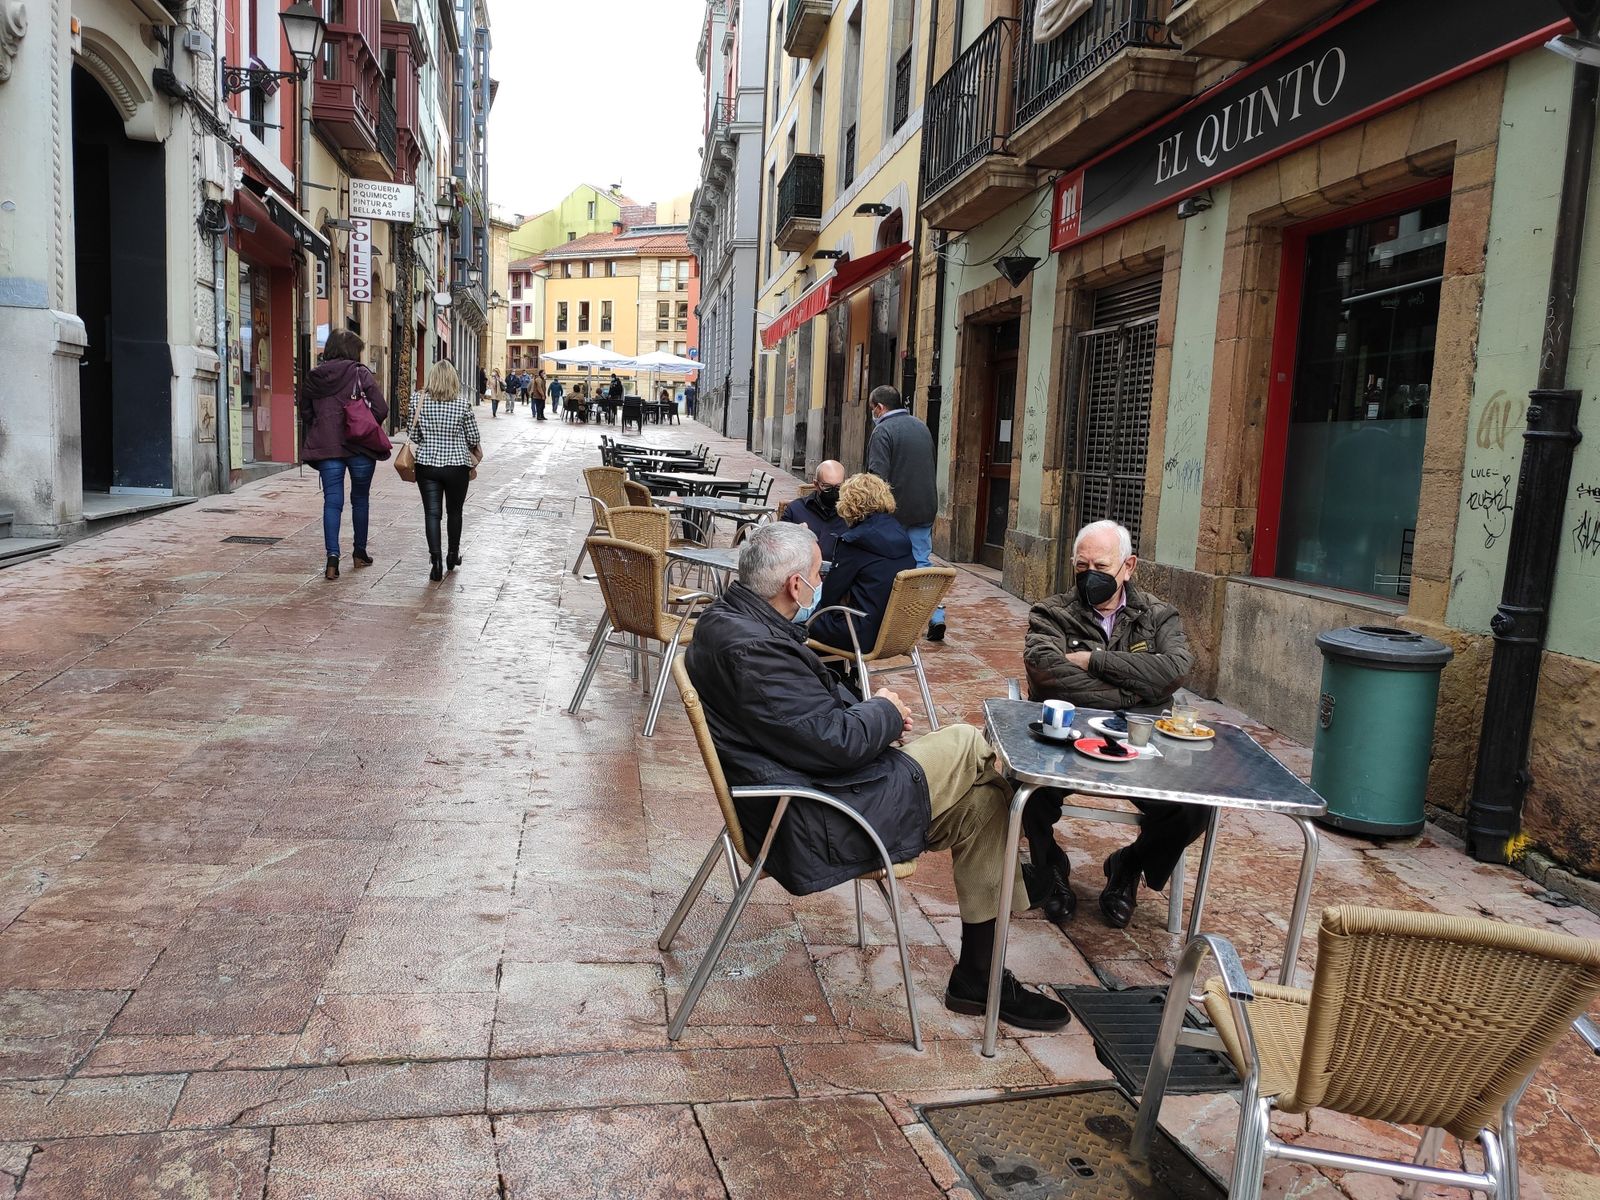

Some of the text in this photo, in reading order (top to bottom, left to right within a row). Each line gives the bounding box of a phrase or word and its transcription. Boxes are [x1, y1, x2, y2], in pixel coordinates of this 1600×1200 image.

[1153, 46, 1347, 186] EL QUINTO
[352, 182, 401, 193] DROGUERIA
[353, 198, 393, 208] PINTURAS
[353, 206, 411, 219] BELLAS ARTES
[351, 220, 370, 299] POLLEDO
